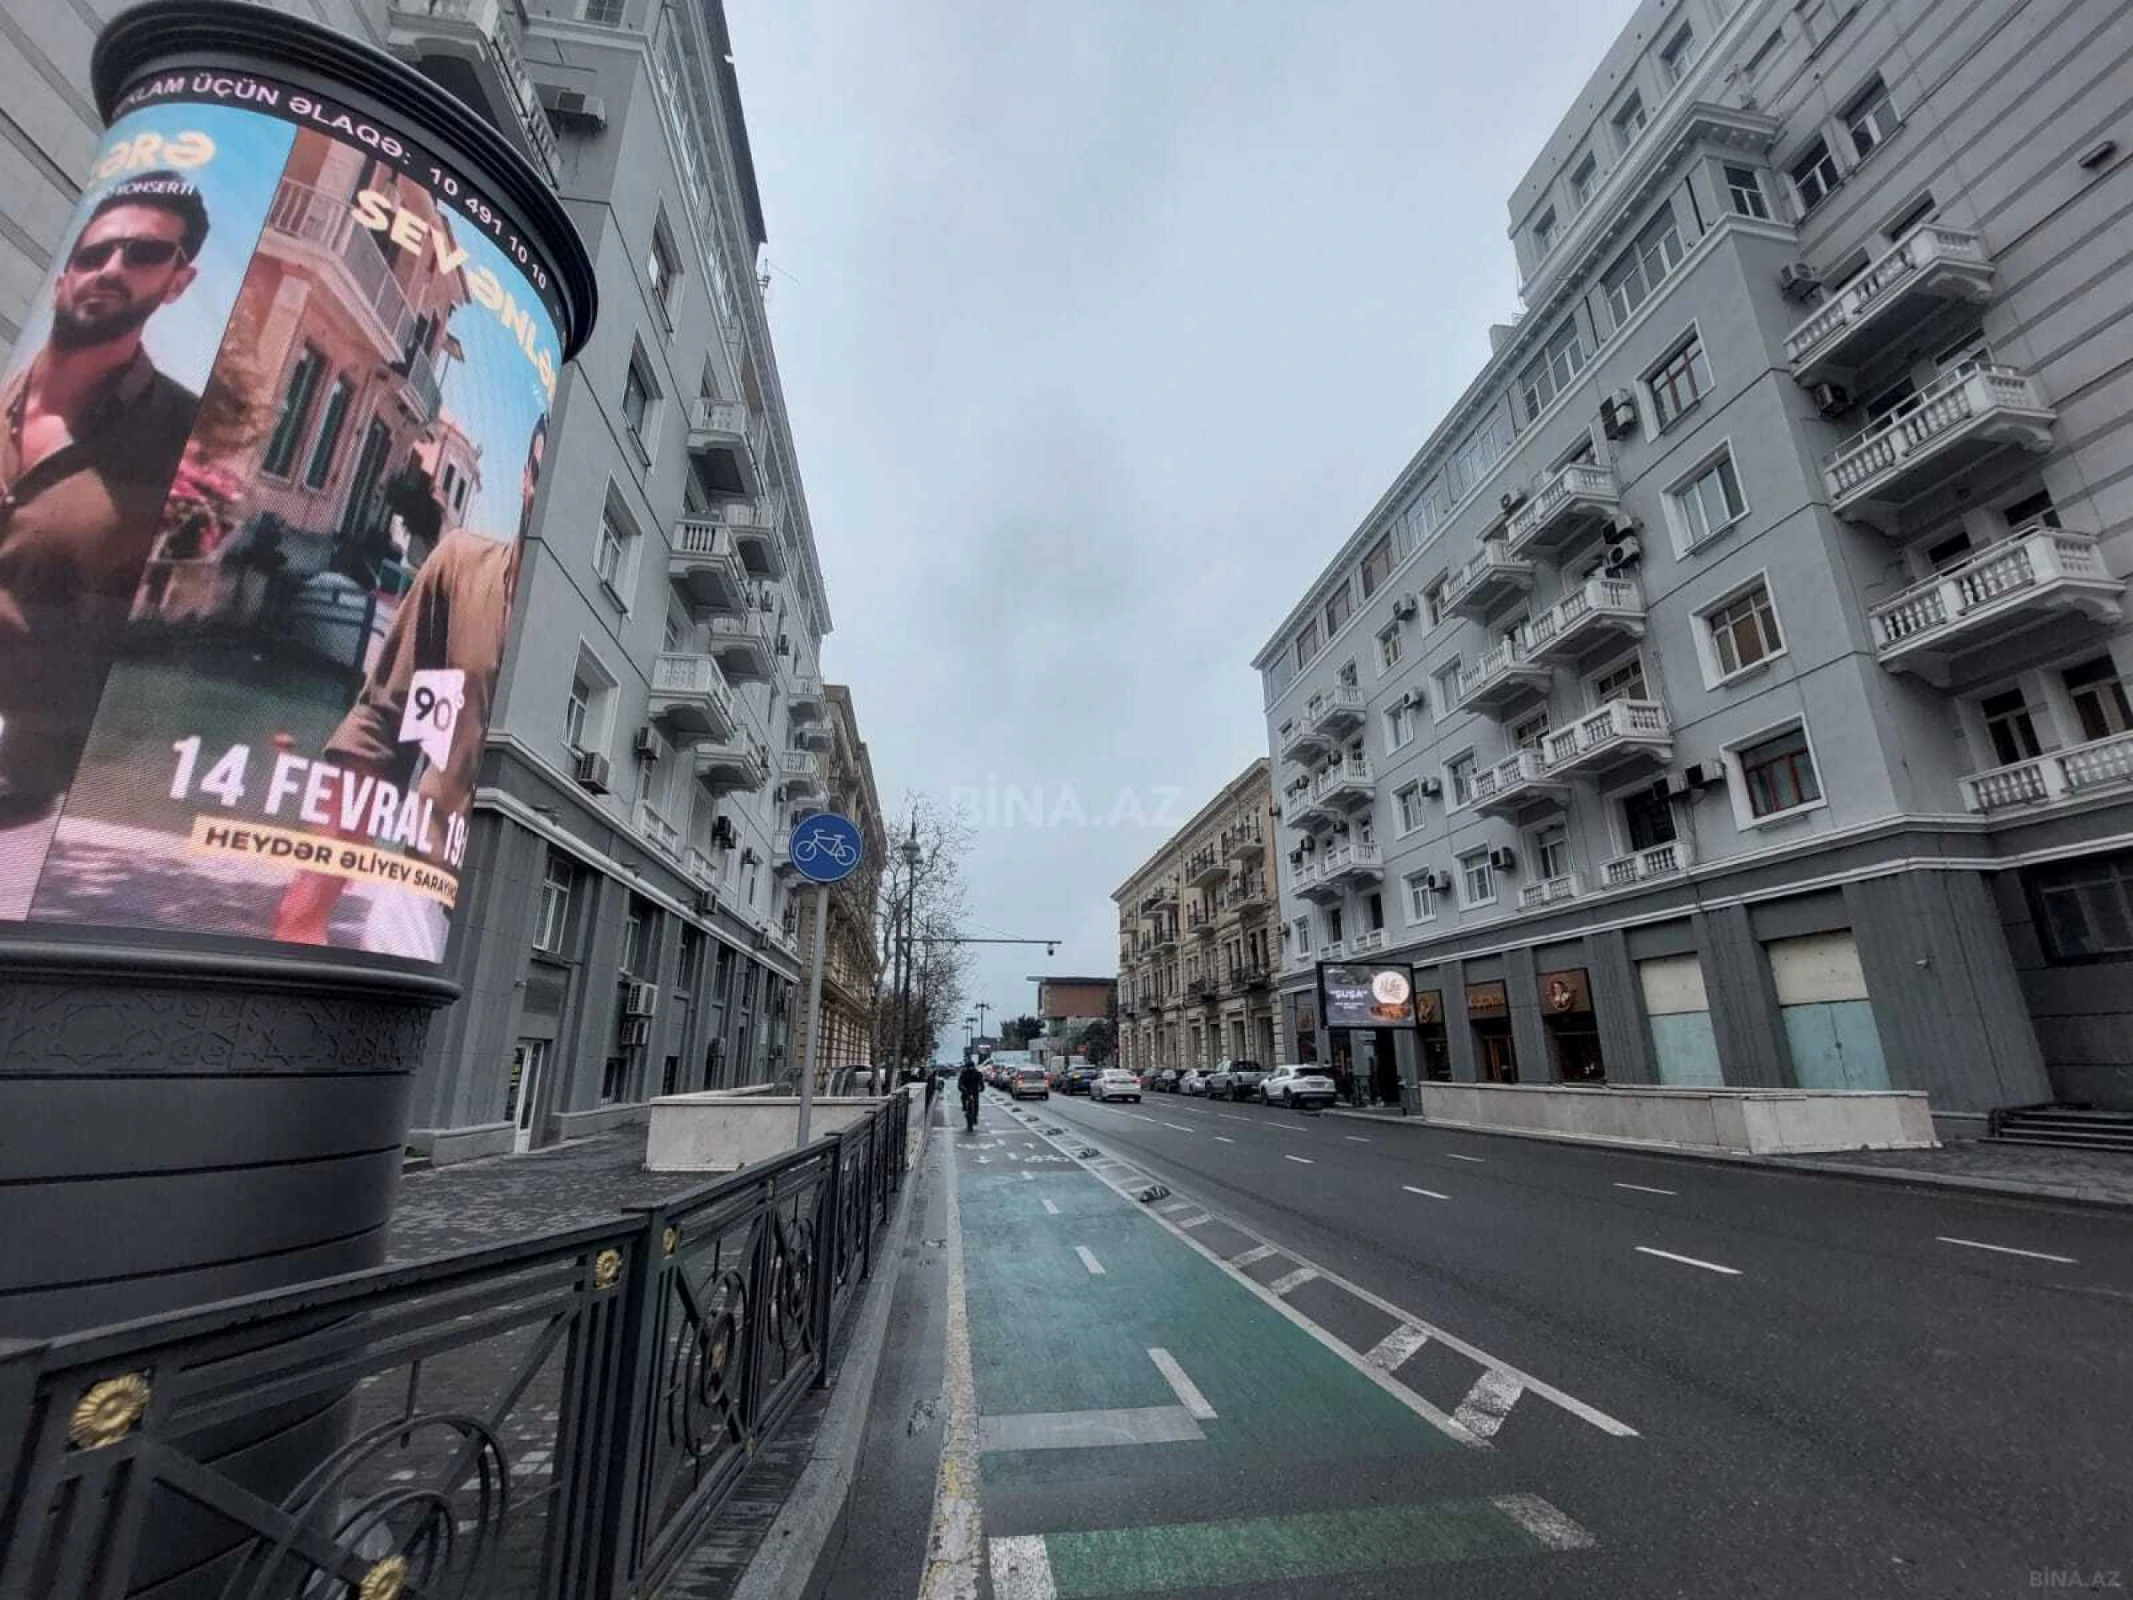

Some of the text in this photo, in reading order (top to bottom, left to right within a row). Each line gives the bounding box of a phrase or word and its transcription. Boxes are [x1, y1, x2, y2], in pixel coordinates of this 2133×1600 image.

[192, 72, 280, 106] ÜÇÜN
[288, 95, 411, 165] ƏLAQƏ:
[429, 167, 459, 196] 10
[465, 197, 502, 236] 491
[508, 236, 529, 264] 10
[531, 263, 547, 290] 10
[170, 735, 250, 806] 14
[264, 751, 436, 853] FEVRAL
[205, 826, 333, 865] HEYDƏR
[340, 851, 411, 881] ƏLİYEV
